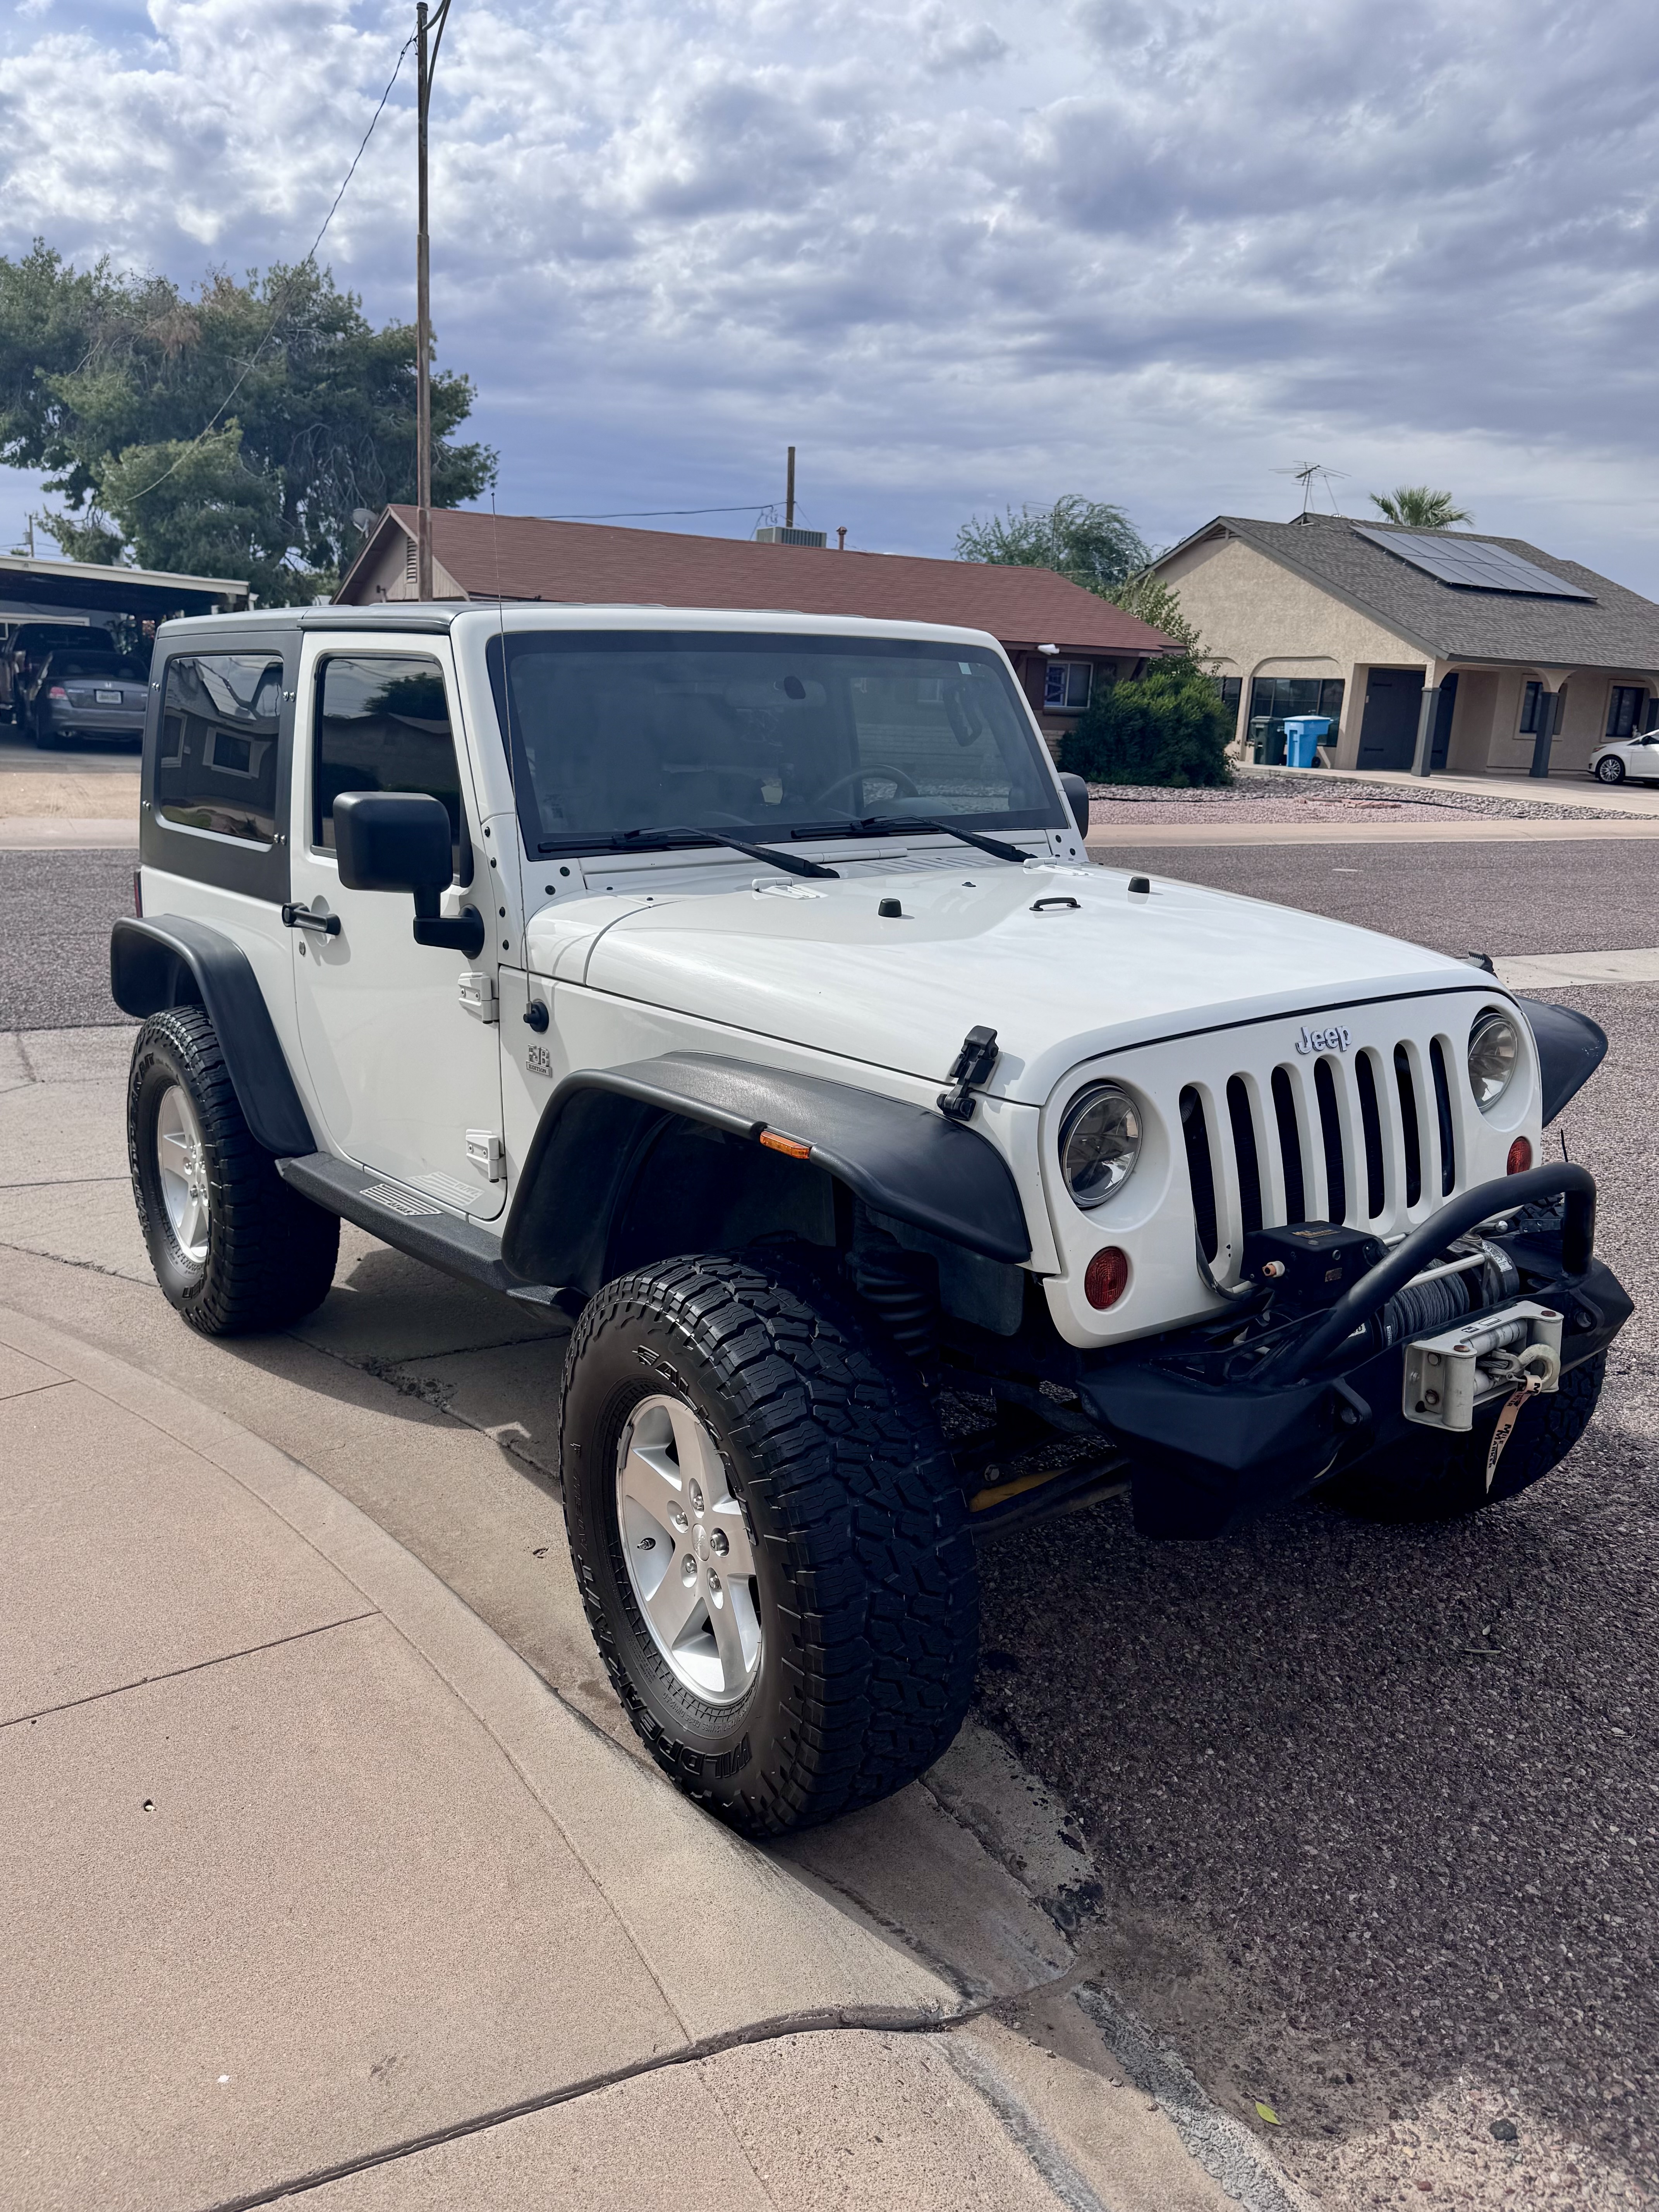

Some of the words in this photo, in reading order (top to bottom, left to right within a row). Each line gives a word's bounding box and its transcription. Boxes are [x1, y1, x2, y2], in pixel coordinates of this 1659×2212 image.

[1295, 1025, 1352, 1054] Jeep
[528, 1044, 550, 1067] FJB
[529, 1063, 547, 1074] EDITION
[1499, 1423, 1512, 1445] MILE
[1488, 1429, 1503, 1469] MARKER
[608, 1654, 752, 1779] WILDPEAK
